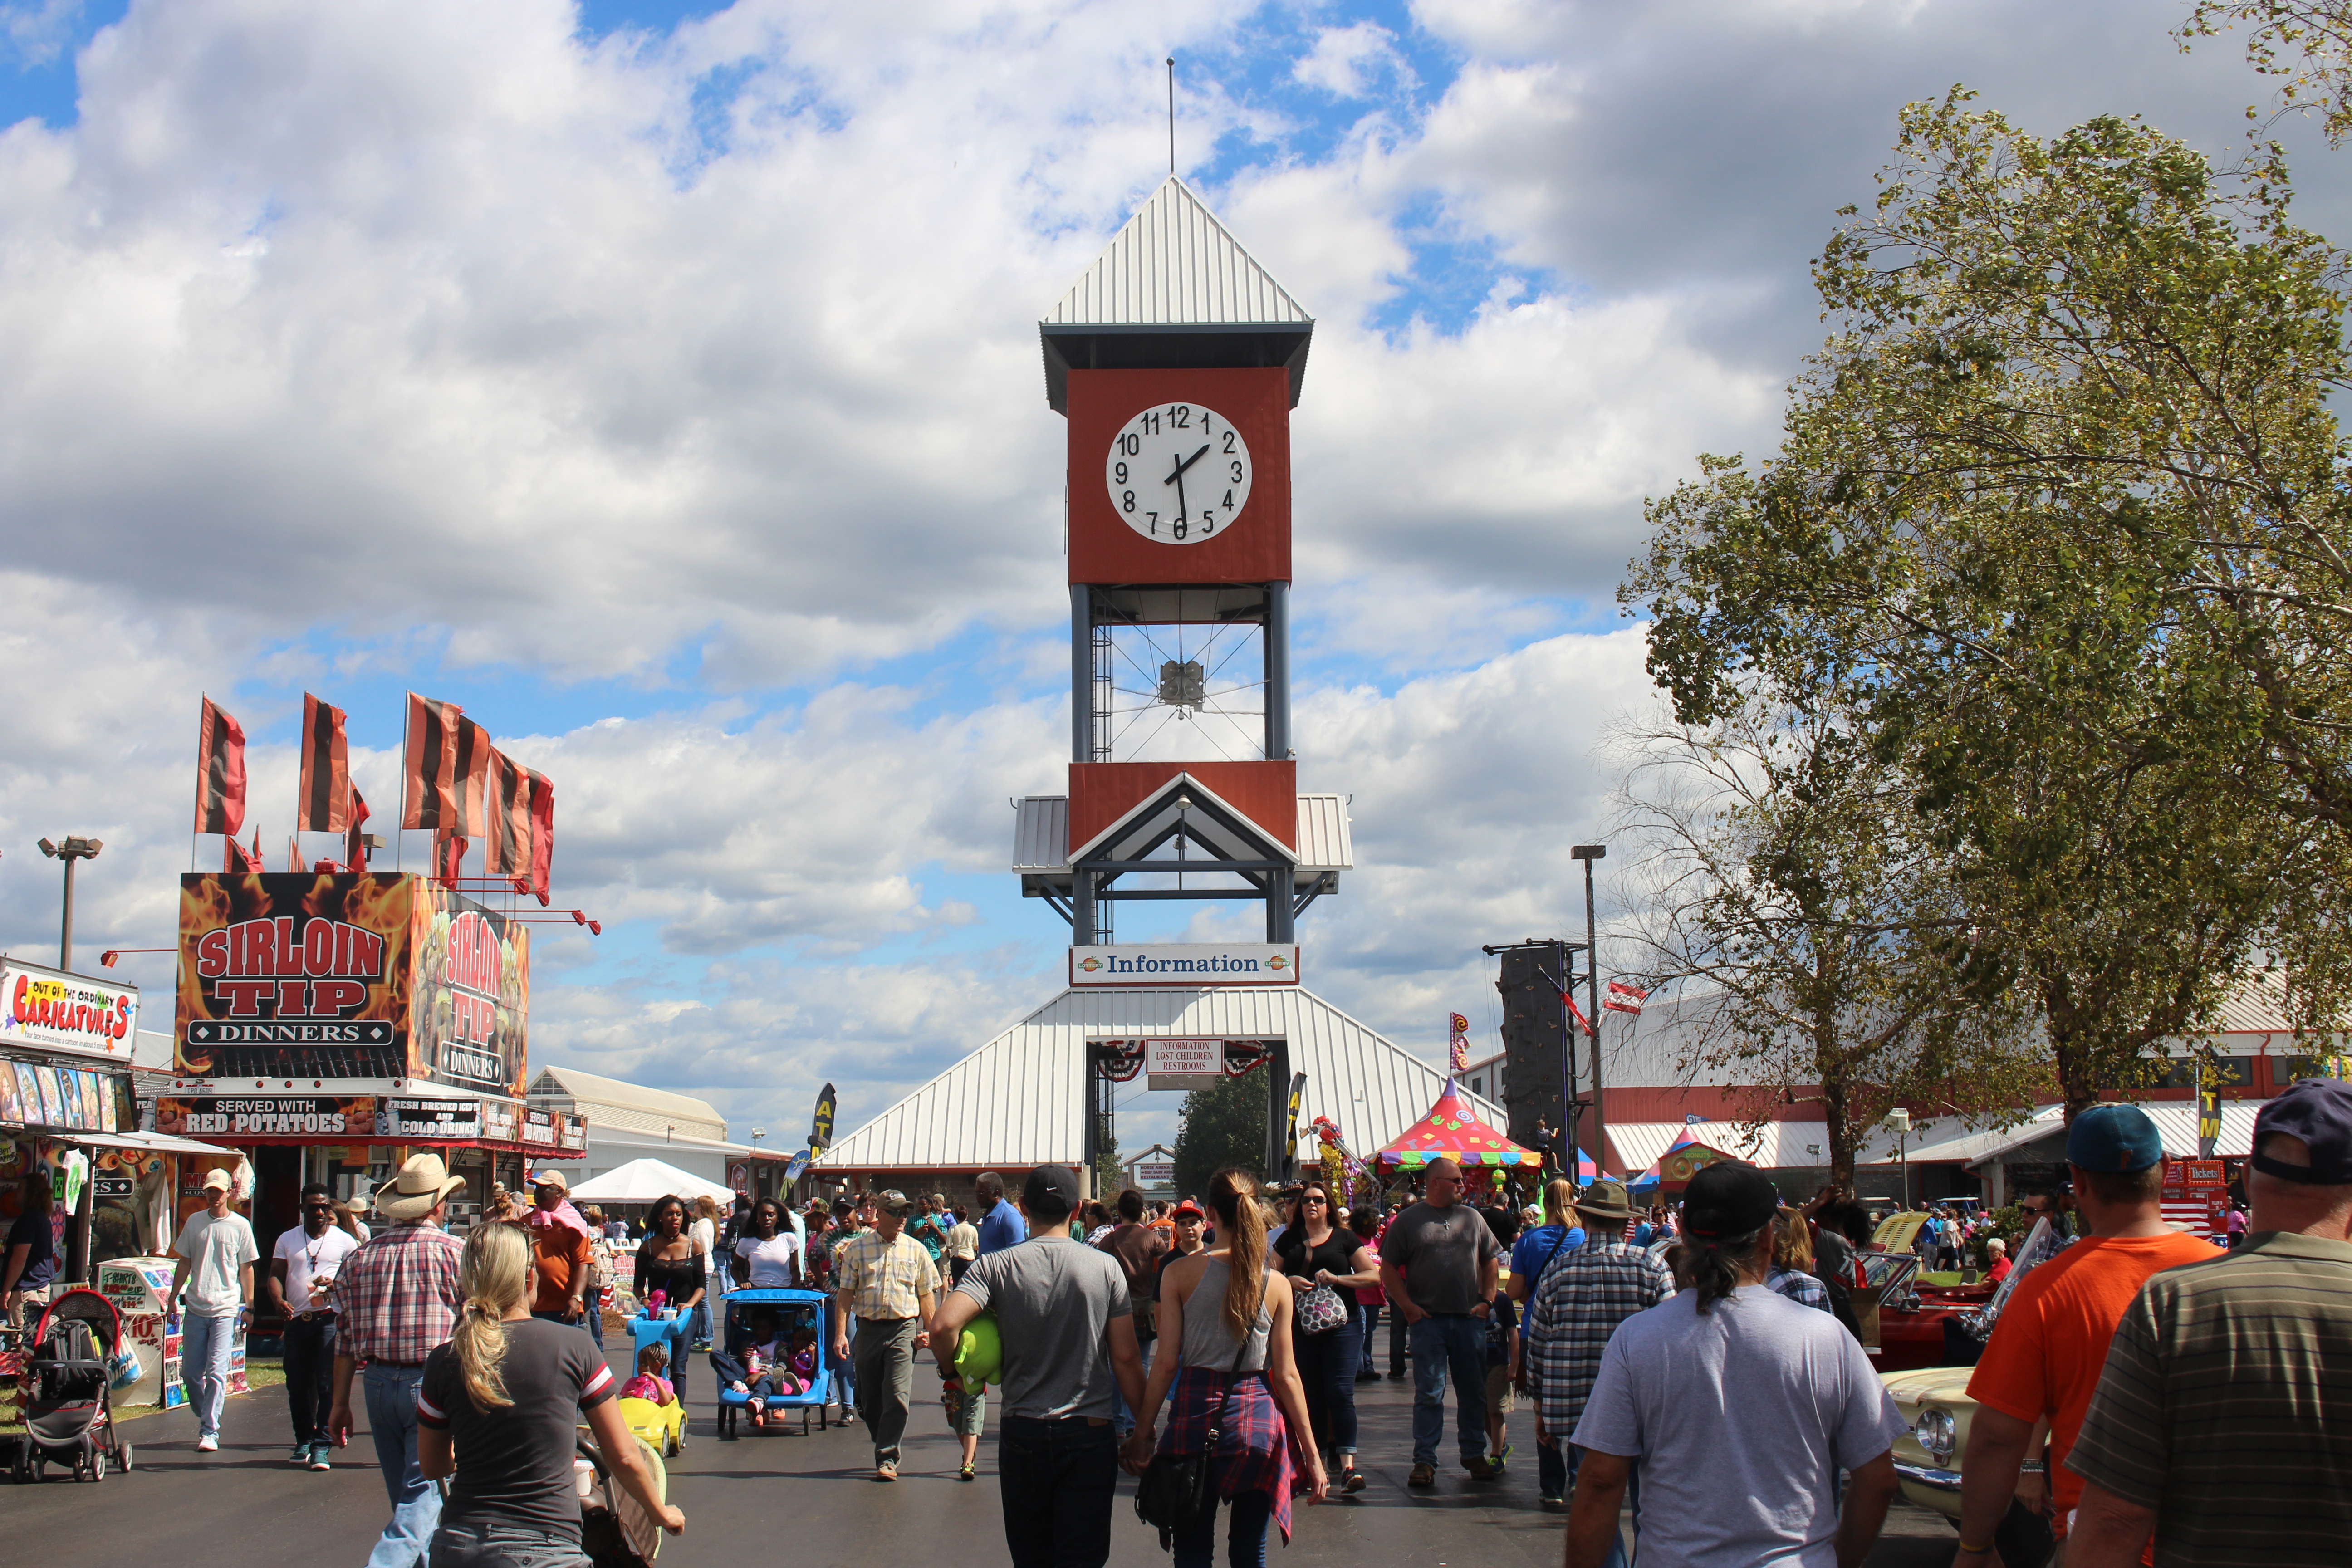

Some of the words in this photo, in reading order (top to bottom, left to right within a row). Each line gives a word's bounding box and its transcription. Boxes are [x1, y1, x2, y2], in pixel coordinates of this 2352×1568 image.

[1141, 412, 1159, 435] 11
[1167, 406, 1189, 428] 12
[1201, 412, 1209, 434] 1
[1117, 434, 1139, 456] 10
[1223, 431, 1235, 453] 2
[1116, 462, 1127, 484] 9
[1231, 461, 1242, 483] 3
[1124, 490, 1135, 512] 8
[1222, 489, 1234, 511] 4
[1146, 512, 1157, 534] 7
[1174, 518, 1186, 540] 6
[1202, 511, 1213, 533] 5
[197, 916, 382, 978] SIRLOIN
[446, 910, 502, 1000] SIRLOIN
[1107, 954, 1259, 973] Information
[34, 981, 49, 995] OUT
[52, 986, 60, 997] OF
[64, 988, 76, 999] THE
[78, 990, 114, 1007] ORDINARY
[215, 980, 366, 1016] TIP
[13, 975, 128, 1039] CARICATURES
[451, 988, 495, 1046] TIP
[24, 1030, 33, 1039] Your
[33, 1032, 41, 1040] face
[42, 1034, 54, 1042] turned
[218, 1025, 360, 1041] DINNERS
[1156, 1052, 1173, 1060] LOST
[1176, 1052, 1213, 1060] CHILDREN
[1160, 1042, 1210, 1050] INFORMATION
[450, 1050, 493, 1079] DINNERS
[1163, 1062, 1206, 1070] RESTROOMS
[216, 1100, 274, 1112] SERVED
[278, 1100, 316, 1112] WITH
[388, 1100, 419, 1110] FRESH
[421, 1101, 457, 1111] BREWED
[459, 1102, 473, 1112] ICED
[2200, 1066, 2219, 1138] ATM
[186, 1113, 228, 1132] RED
[235, 1113, 346, 1132] POTATOES
[401, 1121, 436, 1133] COLD
[439, 1122, 475, 1134] DRINKS
[529, 1111, 541, 1123] SERVED
[524, 1122, 533, 1140] RED
[2190, 1167, 2218, 1178] Tickets
